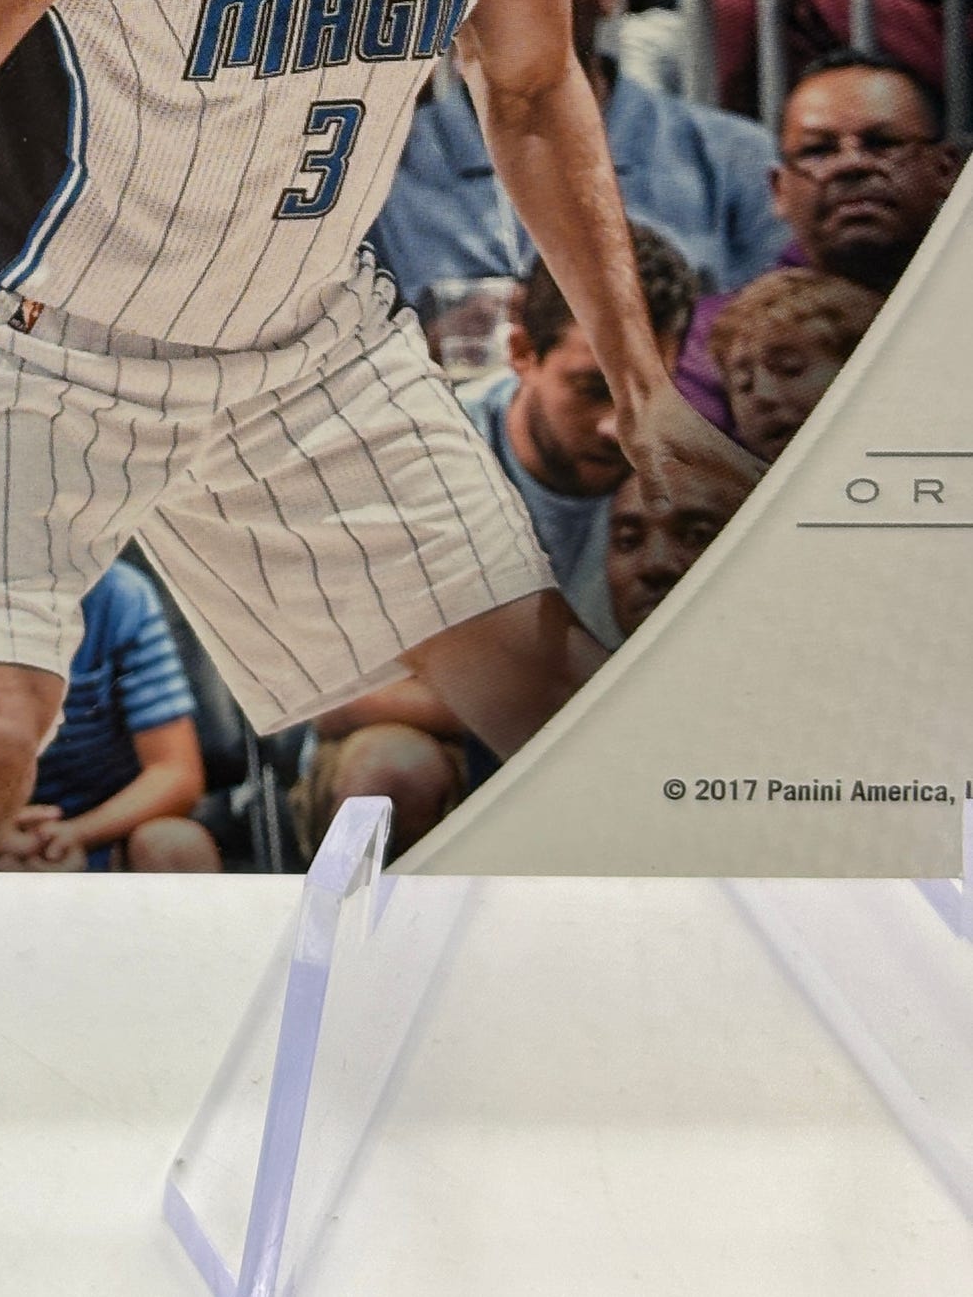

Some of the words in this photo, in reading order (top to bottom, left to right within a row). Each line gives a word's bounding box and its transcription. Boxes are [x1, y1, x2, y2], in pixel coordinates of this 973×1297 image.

[272, 99, 366, 221] 3
[694, 779, 758, 801] 2017
[767, 779, 842, 802] Panini
[850, 779, 955, 806] America,
